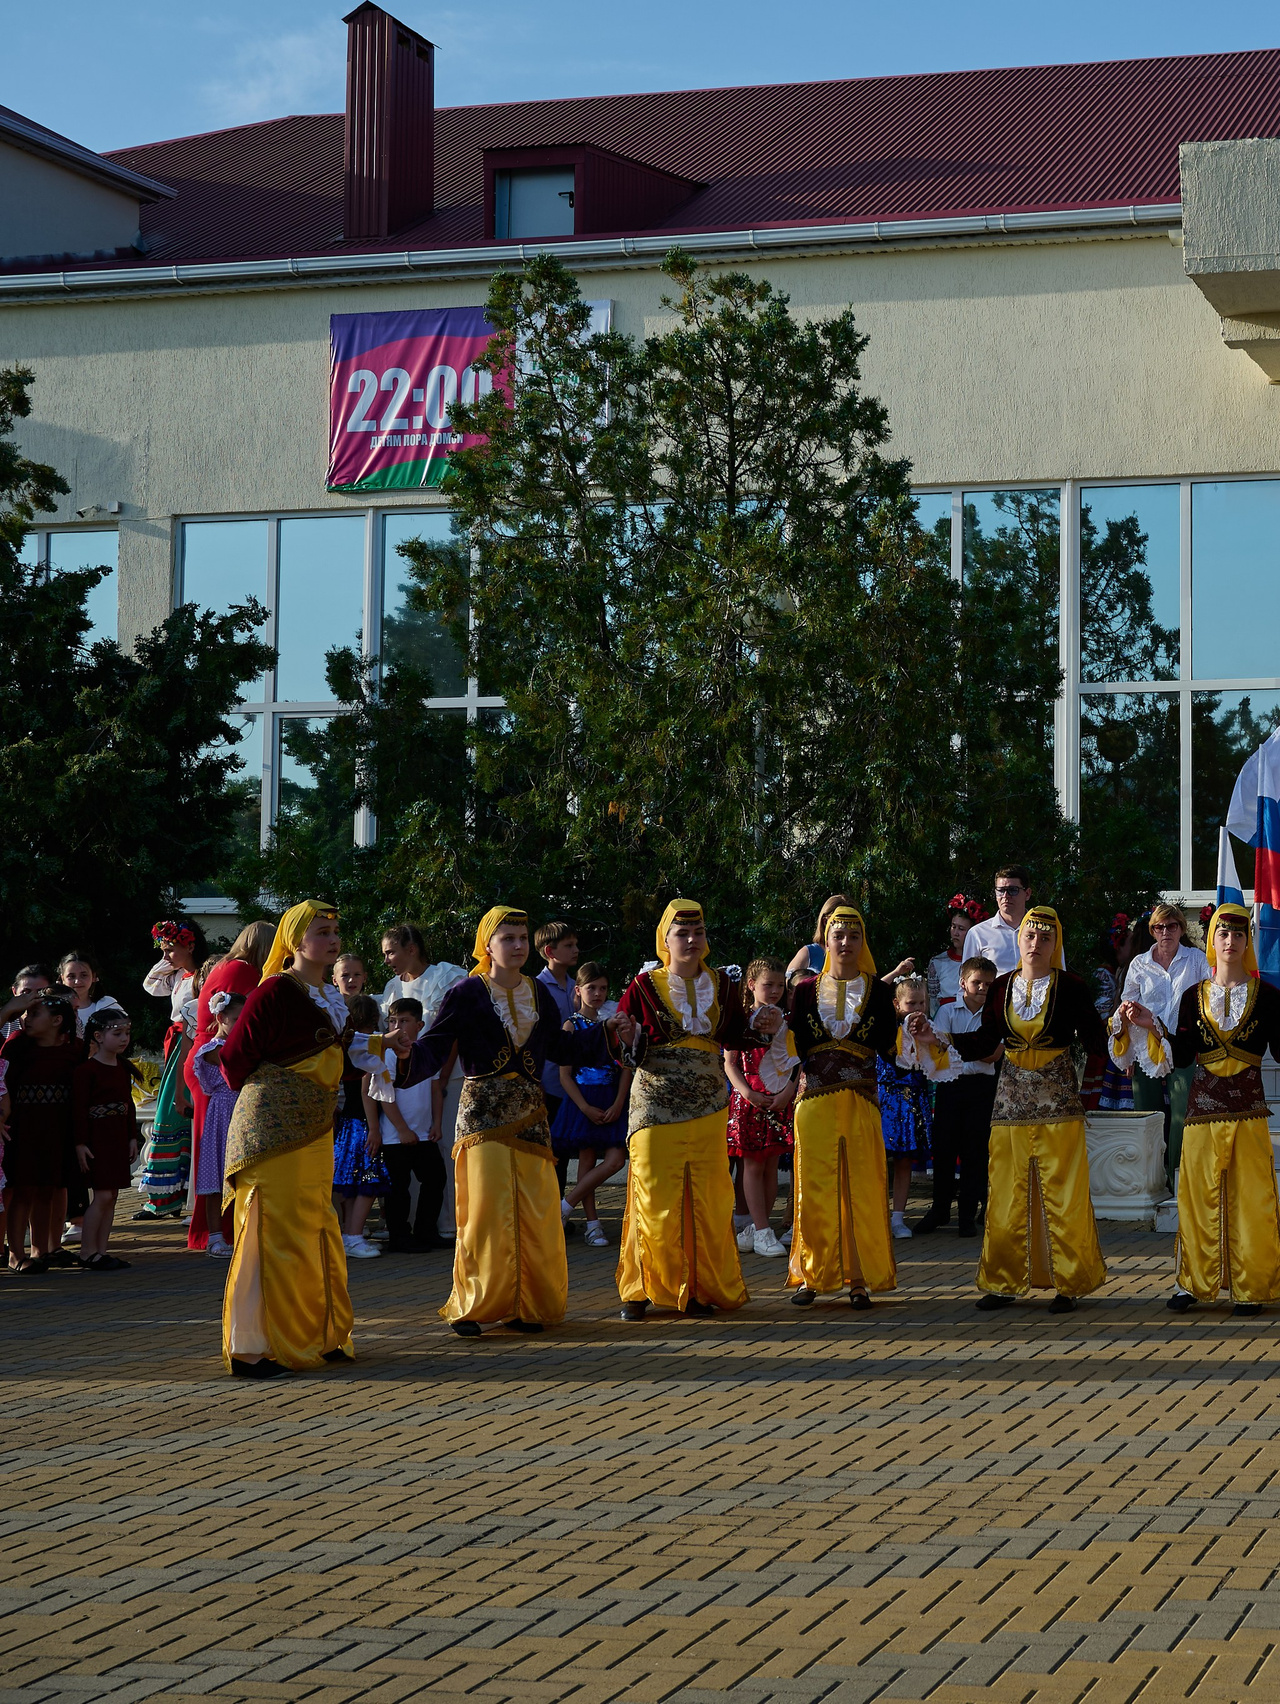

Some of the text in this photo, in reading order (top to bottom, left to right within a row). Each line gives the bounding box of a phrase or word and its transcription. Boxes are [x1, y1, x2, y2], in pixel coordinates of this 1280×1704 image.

[347, 365, 493, 432] 22:00
[370, 435, 401, 450] ДЕТЯМ
[403, 434, 428, 447] ПОРА
